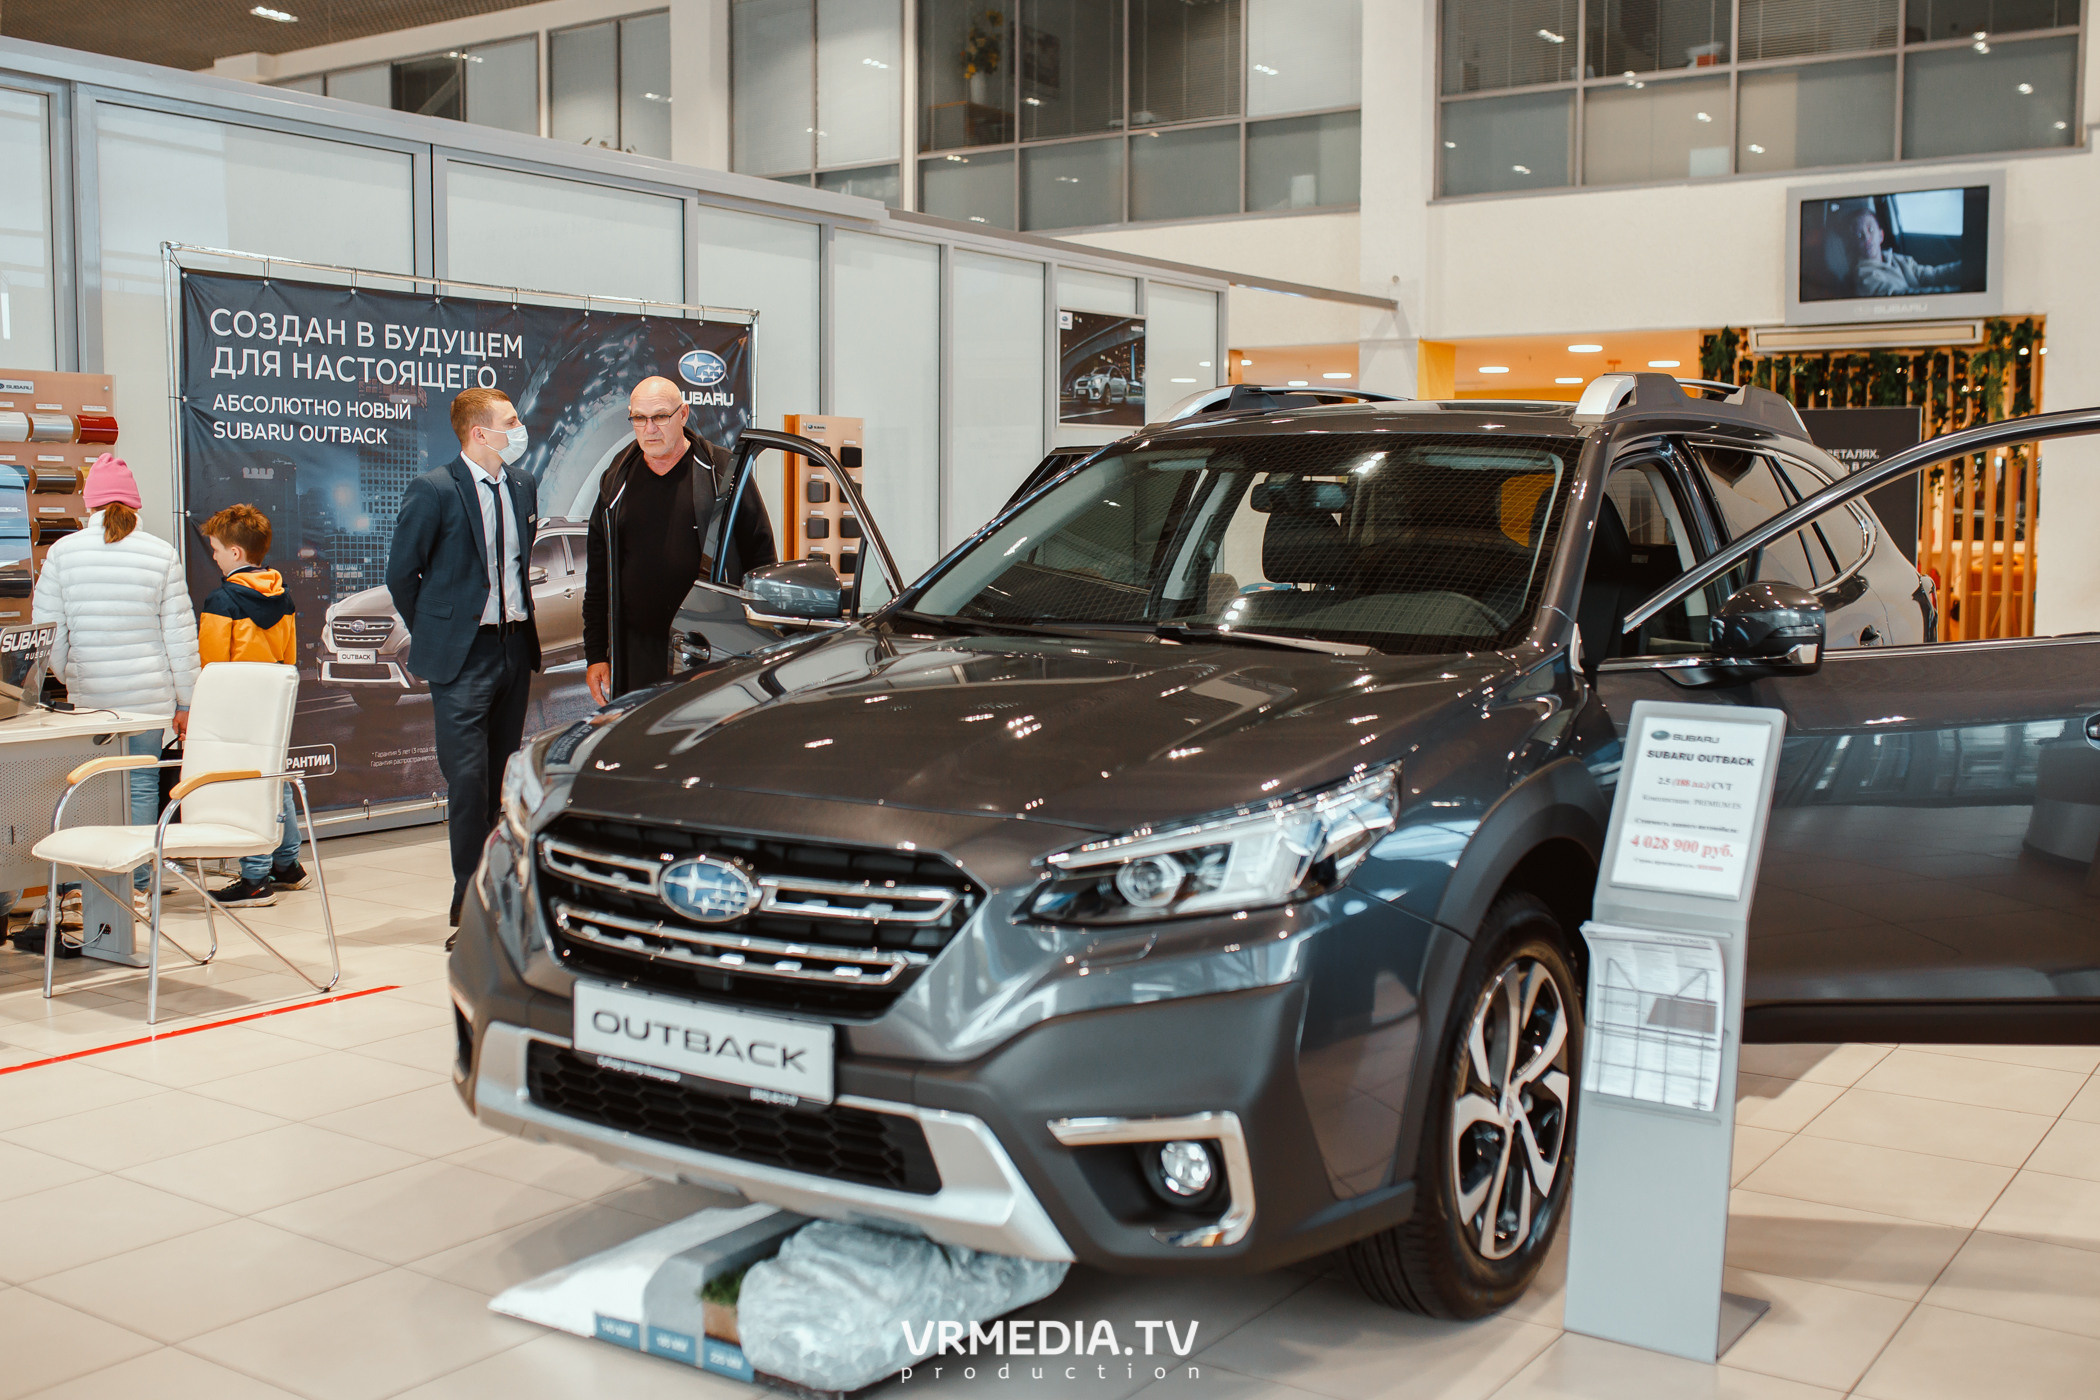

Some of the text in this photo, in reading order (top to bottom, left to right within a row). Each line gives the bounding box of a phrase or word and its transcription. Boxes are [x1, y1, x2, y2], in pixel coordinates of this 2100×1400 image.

[210, 308, 523, 360] СОЗДАН В БУДУЩЕМ
[210, 346, 497, 392] ДЛЯ НАСТОЯЩЕГО
[212, 393, 411, 420] АБСОЛЮТНО НОВЫЙ
[681, 391, 734, 406] UBARU
[213, 421, 388, 444] SUBARU OUTBACK
[1, 626, 57, 653] SUBARU
[25, 650, 51, 661] RUSSIA
[1672, 734, 1720, 744] SUBARU
[286, 753, 331, 769] РАНТИИ
[1647, 750, 1755, 766] SUBARU OUTBACK
[1712, 782, 1732, 791] CVT
[1631, 835, 1734, 859] 4 028 900 руб.
[593, 1011, 806, 1074] OUTBACK
